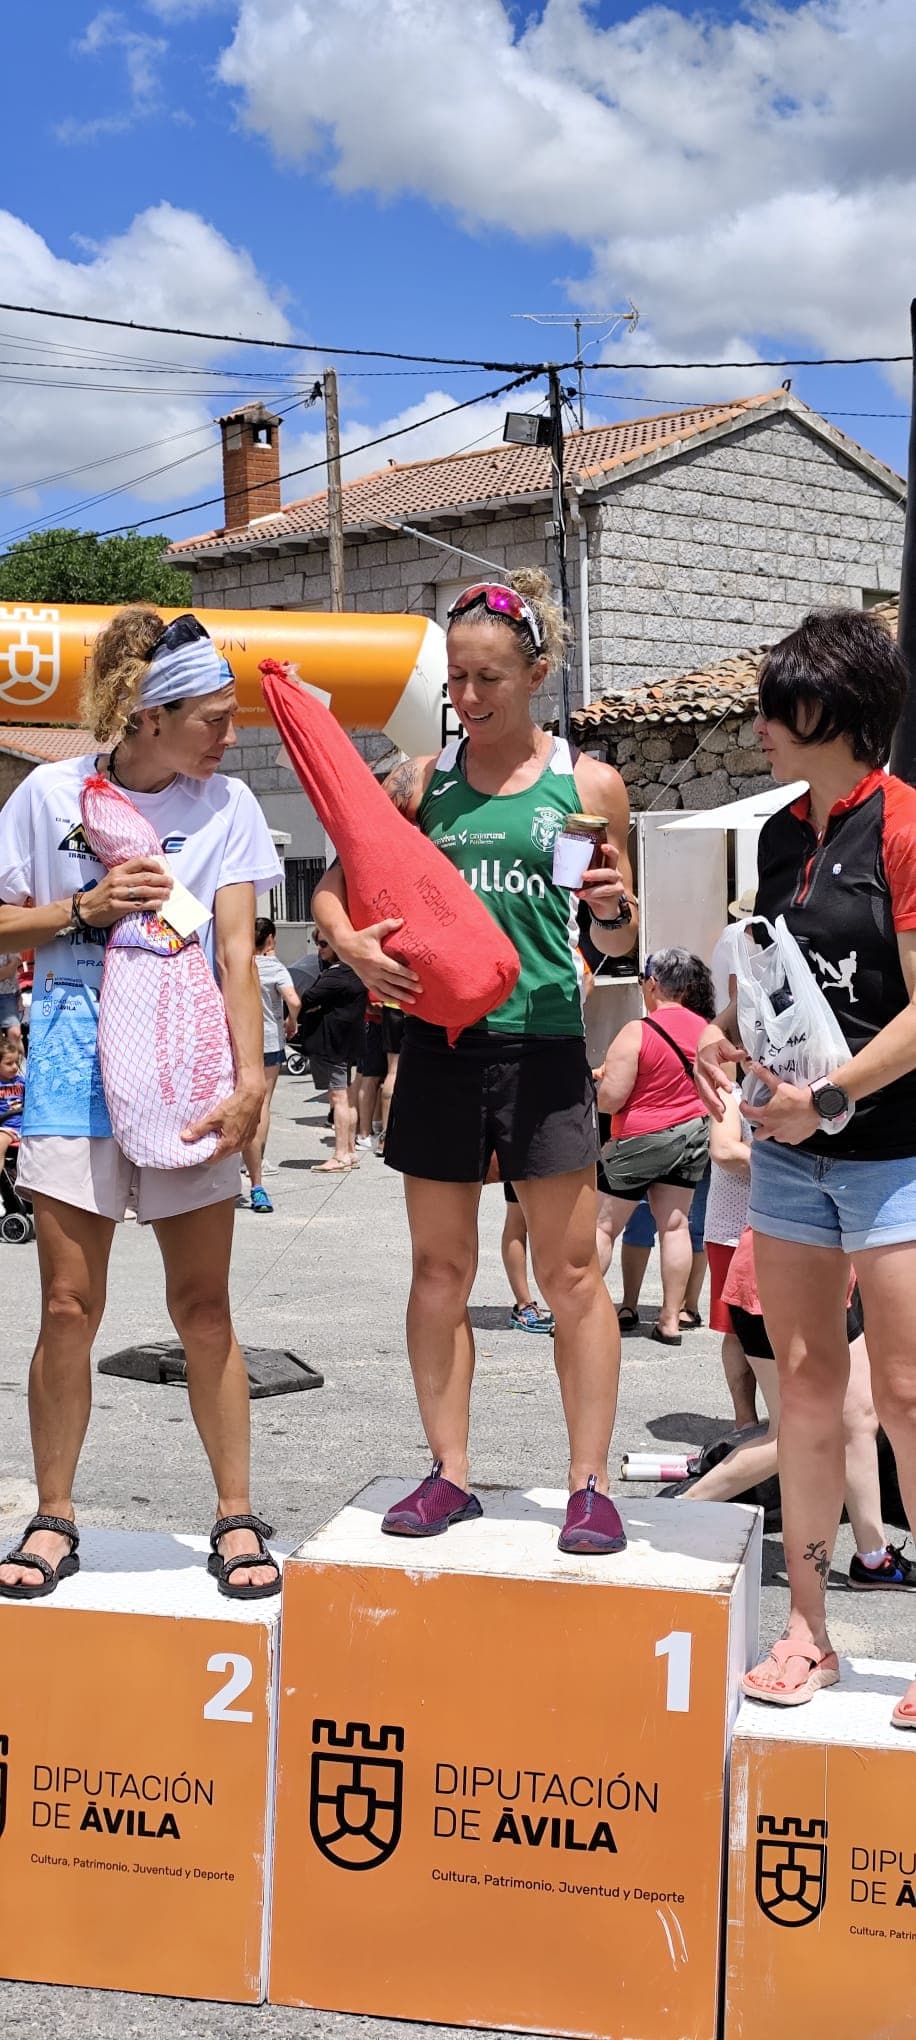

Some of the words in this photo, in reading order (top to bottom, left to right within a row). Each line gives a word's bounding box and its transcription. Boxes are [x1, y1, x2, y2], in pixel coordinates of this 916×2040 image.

[458, 859, 546, 899] ullón
[204, 1653, 253, 1723] 2
[655, 1630, 692, 1712] 1
[33, 1764, 214, 1806] DIPUTACIÓN
[434, 1763, 658, 1813] DIPUTACIÓN
[32, 1801, 71, 1830] DE
[433, 1806, 481, 1841] DE
[30, 1853, 70, 1867] Cultura,
[73, 1857, 130, 1873] Patrimonio,
[132, 1863, 183, 1877] Juventud
[184, 1869, 192, 1880] y
[193, 1868, 235, 1882] Deporte
[431, 1868, 481, 1886] Cultura,
[484, 1874, 556, 1893] Patrimonio,
[558, 1881, 620, 1898] Juventud
[623, 1889, 631, 1901] y
[633, 1888, 685, 1904] Deporte
[850, 1878, 887, 1905] DE
[849, 1925, 887, 1938] Cultura,
